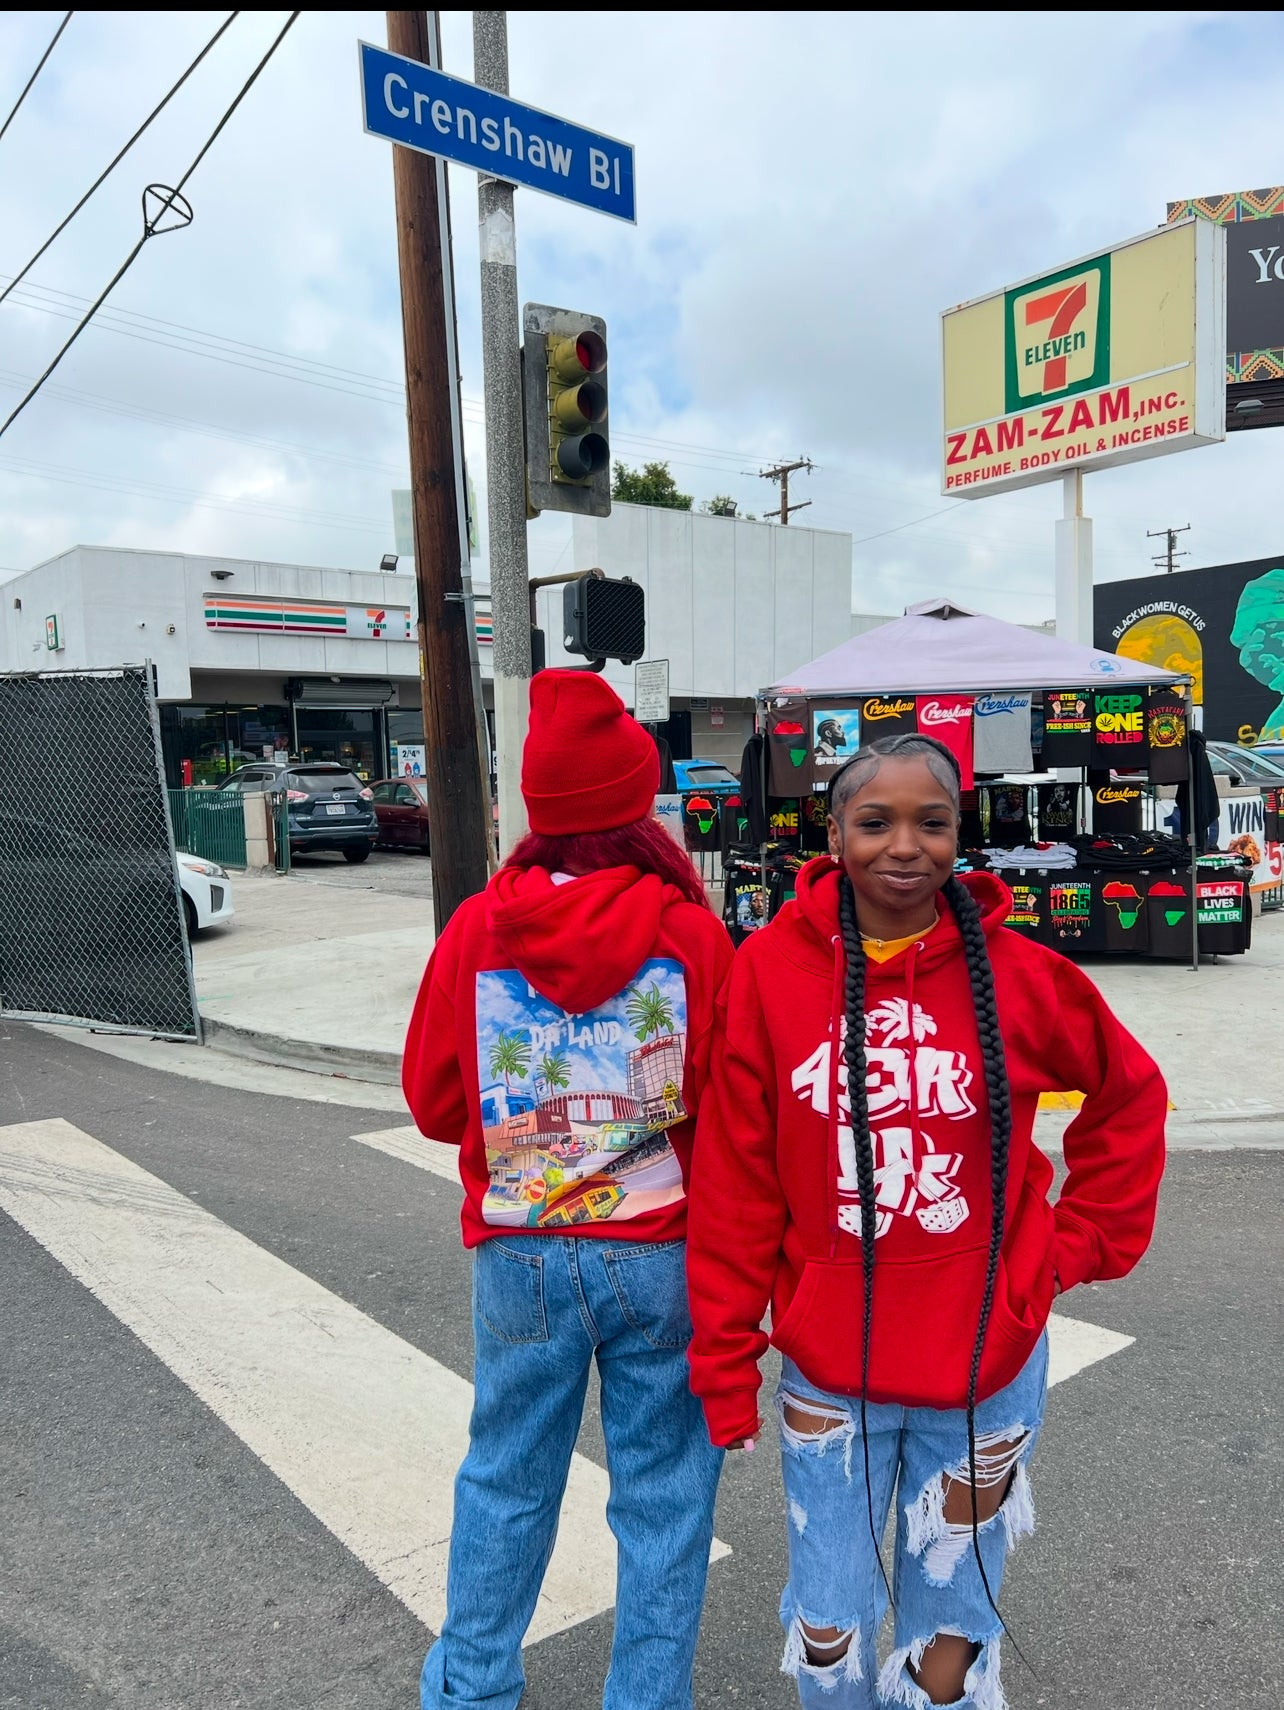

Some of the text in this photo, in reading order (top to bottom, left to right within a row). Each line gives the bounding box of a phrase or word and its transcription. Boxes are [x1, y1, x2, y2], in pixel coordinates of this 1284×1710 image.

[383, 72, 621, 196] Crenshaw Bl
[1025, 281, 1087, 393] 7
[1020, 449, 1061, 470] BODY
[1065, 442, 1091, 460] OIL
[1096, 437, 1107, 452] &
[1112, 416, 1189, 449] INCENSE
[1111, 600, 1206, 639] BLACK WOMEN GET US
[975, 695, 1029, 717] Crenshaw
[1047, 692, 1090, 701] JUNETEENTH
[1094, 694, 1143, 713] KEEP
[863, 697, 915, 721] Crenshaw
[920, 701, 973, 725] Crenshaw
[1095, 711, 1144, 732] ONE
[1096, 731, 1144, 745] ROLLED
[1095, 786, 1140, 804] Crenshaw
[735, 884, 772, 896] MARTN
[1200, 885, 1237, 898] BLACK
[1050, 894, 1090, 909] 1865
[1204, 898, 1235, 909] LIVES
[1198, 910, 1240, 922] MATTER
[567, 1020, 622, 1049] LAND
